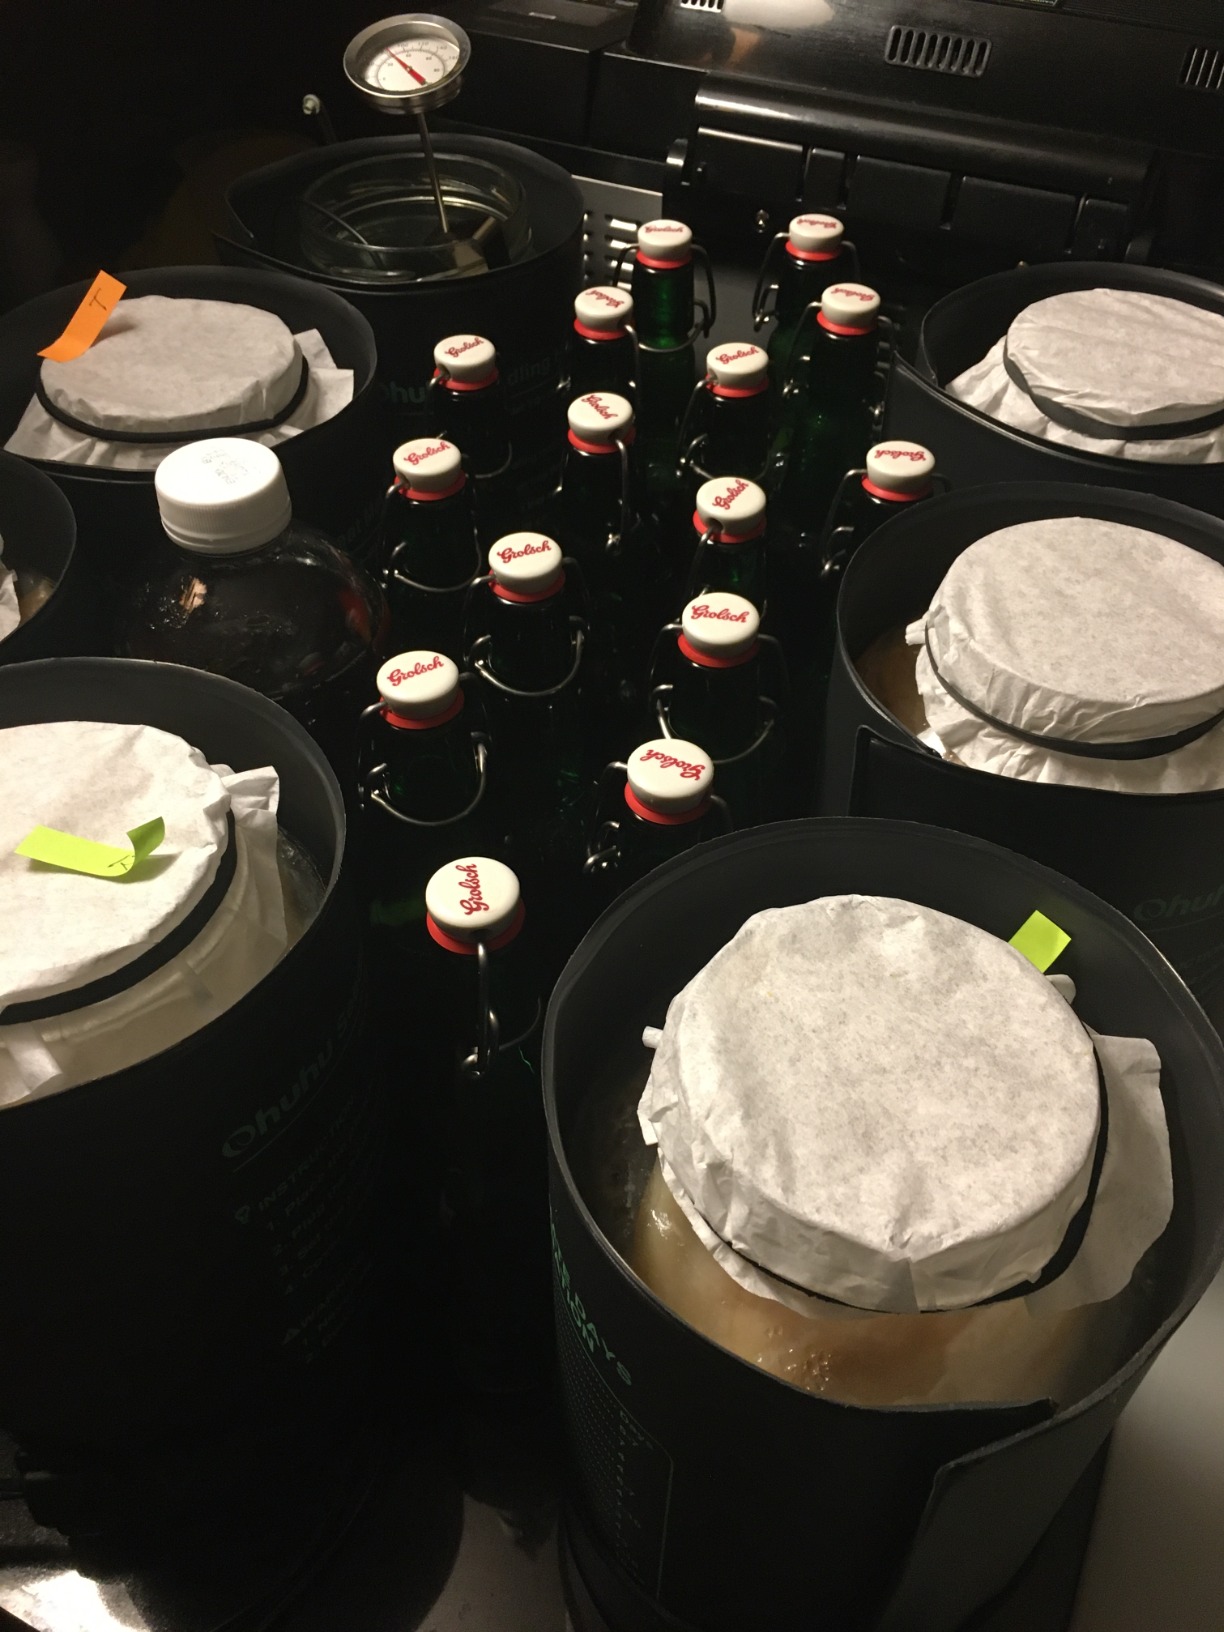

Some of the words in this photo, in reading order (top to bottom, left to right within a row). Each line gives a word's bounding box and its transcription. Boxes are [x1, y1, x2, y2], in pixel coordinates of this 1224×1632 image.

[89, 288, 107, 311] T
[444, 337, 484, 359] Grolsch
[716, 345, 759, 366] Grolsch
[404, 440, 450, 466] Grolsch
[875, 448, 927, 462] Grolsch
[713, 478, 748, 511] Grolsch
[497, 539, 552, 564] Grolsch
[690, 604, 749, 624] Grolsch
[387, 655, 444, 687] Grolsch
[640, 748, 706, 781] Grolsch
[456, 864, 491, 916] Grolsch
[222, 1037, 333, 1158] Ohuhu
